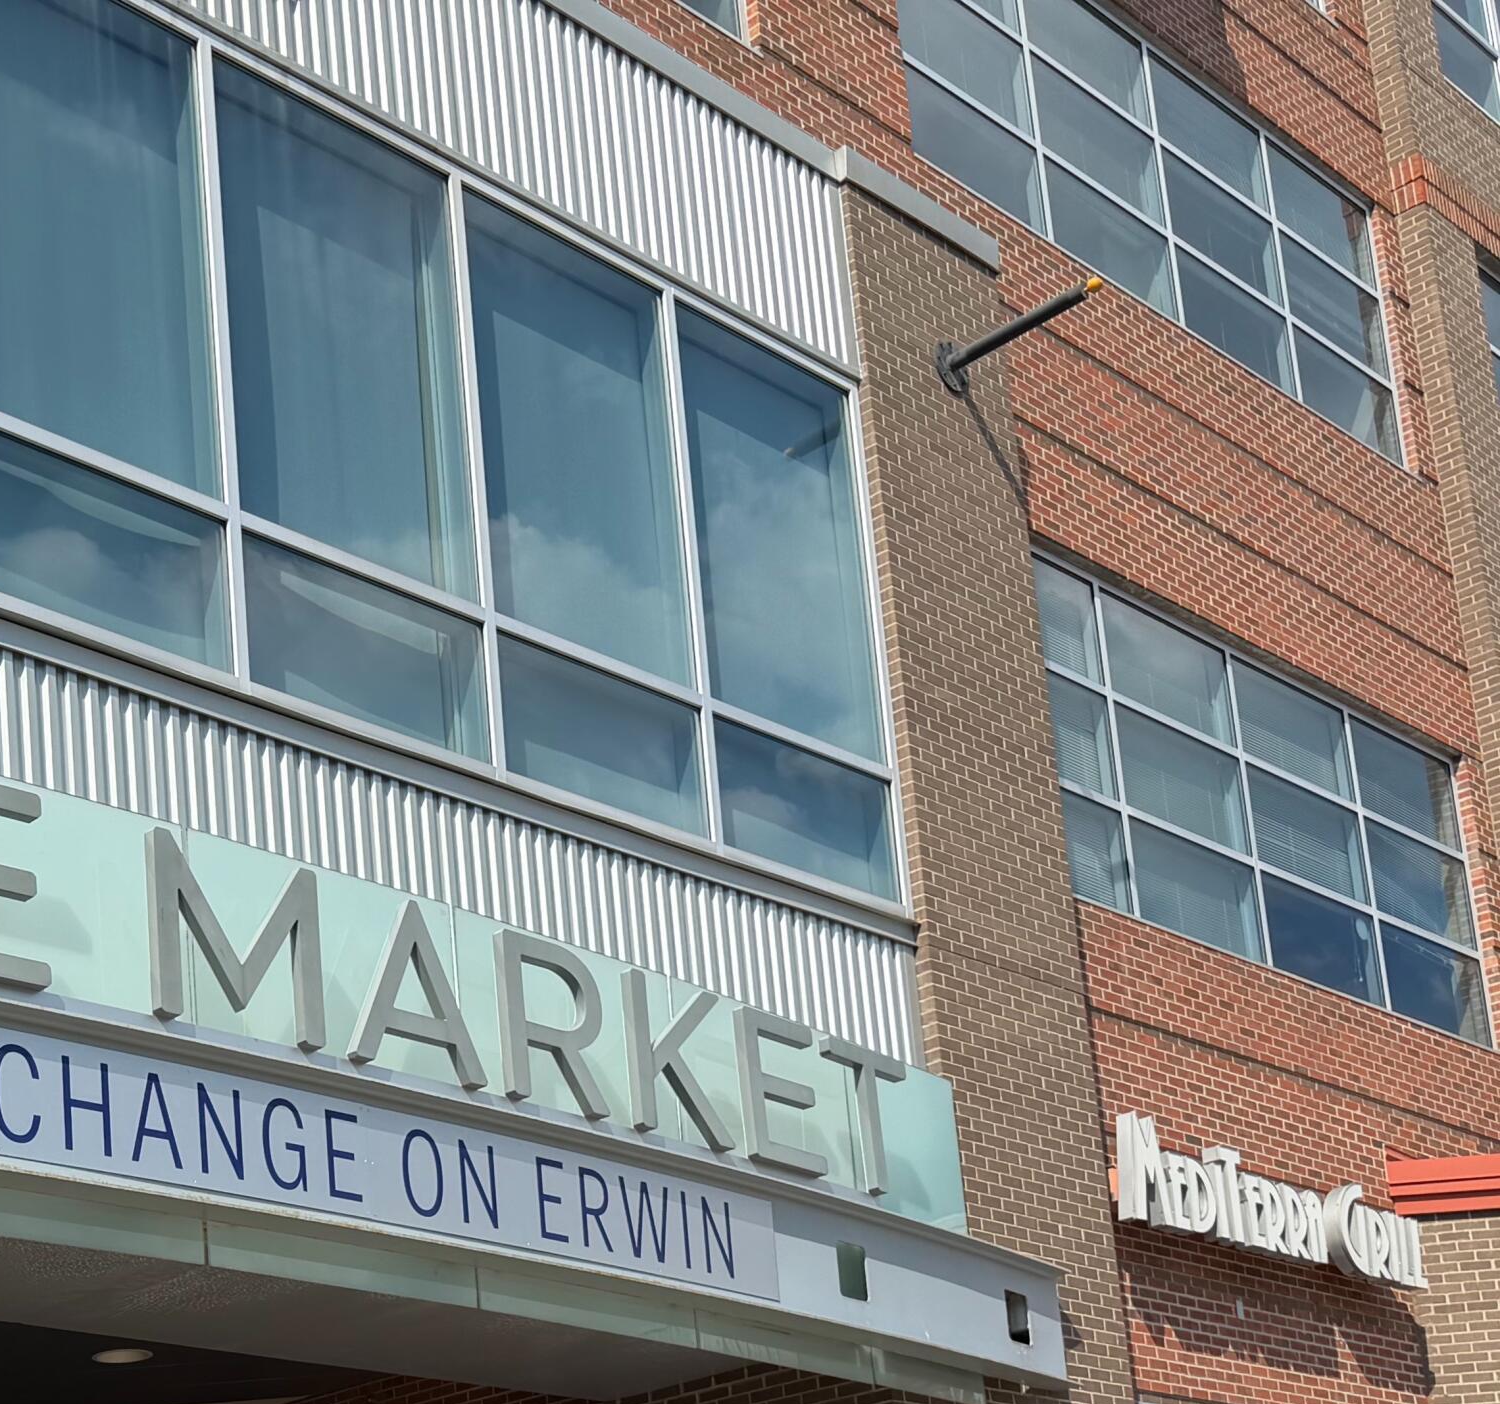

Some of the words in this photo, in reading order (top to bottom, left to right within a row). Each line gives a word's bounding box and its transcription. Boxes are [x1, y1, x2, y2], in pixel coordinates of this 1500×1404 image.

[145, 826, 906, 1196] MARKET
[402, 1129, 499, 1230] ON
[538, 1159, 736, 1280] ERWIN
